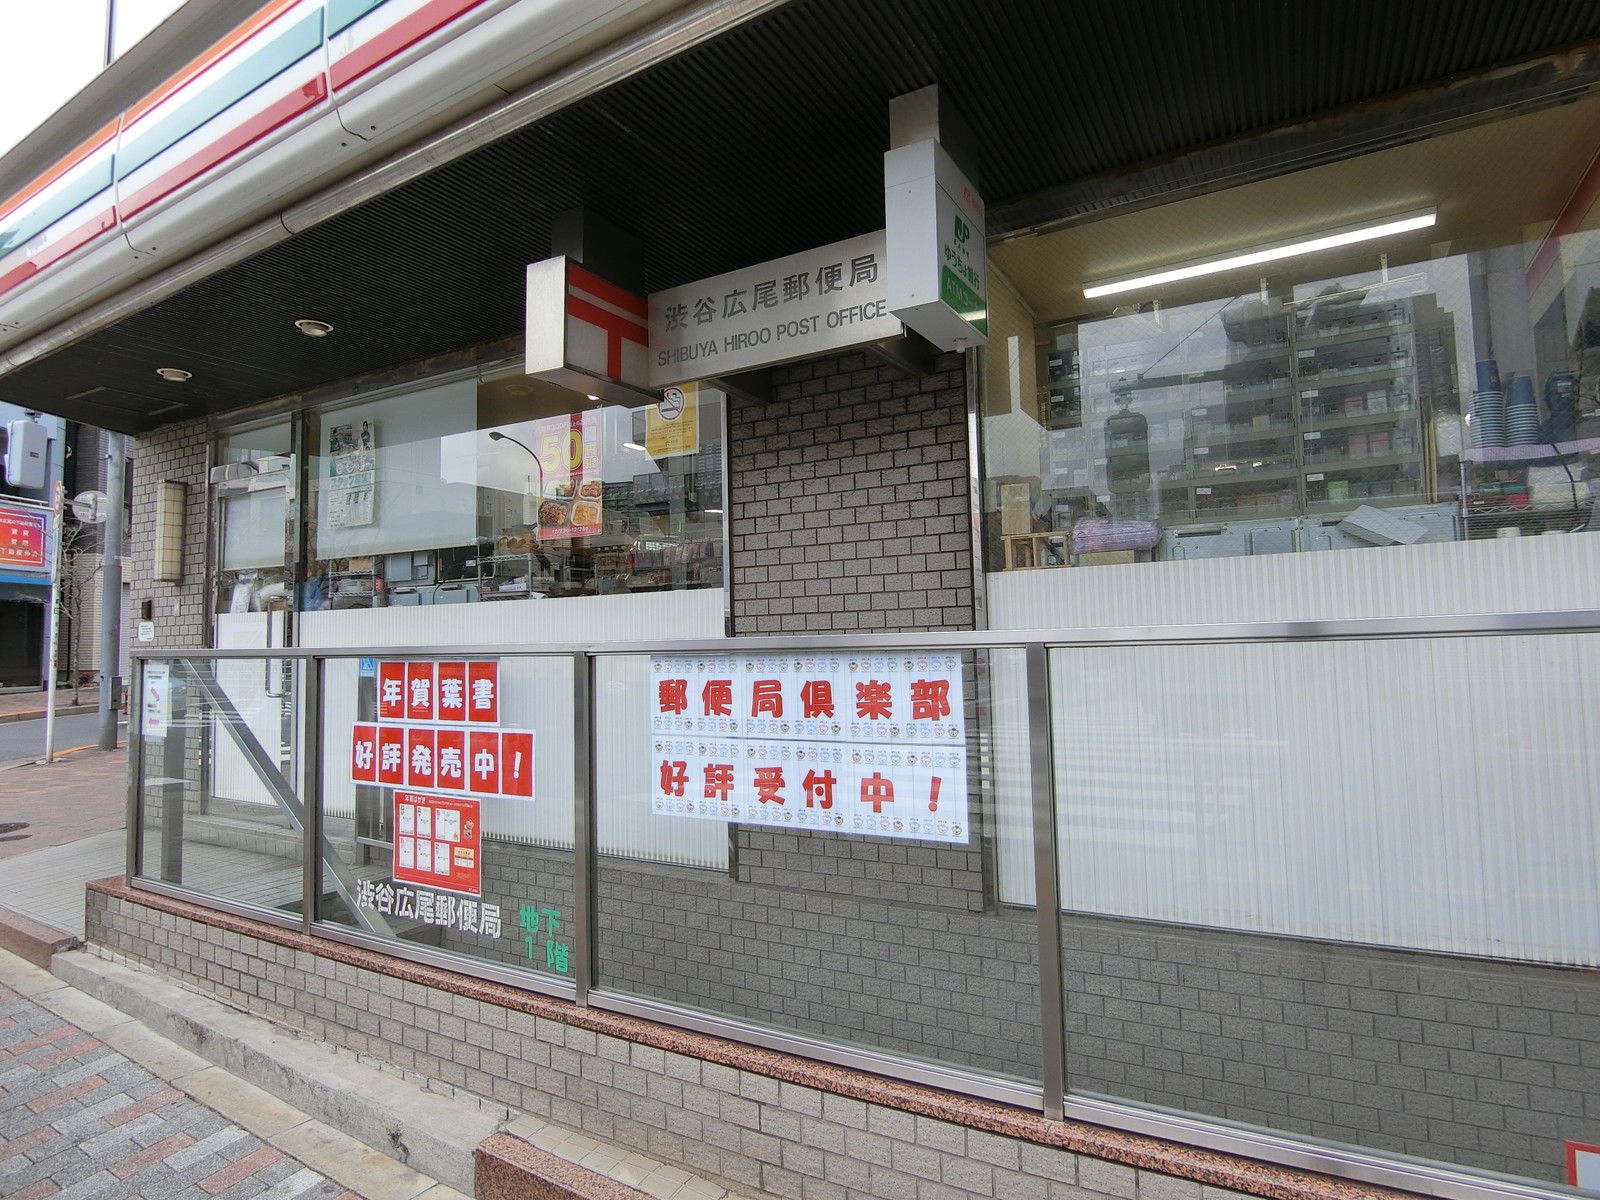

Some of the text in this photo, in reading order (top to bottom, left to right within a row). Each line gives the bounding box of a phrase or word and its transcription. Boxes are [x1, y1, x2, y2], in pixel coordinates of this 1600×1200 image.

[944, 244, 980, 290] ゆうちょ銀行
[664, 254, 879, 333] 渋谷広尾郵便局
[946, 277, 982, 313] ATMコーナ
[658, 299, 887, 367] SHIBUYA HIROO POST OFFICE
[382, 678, 494, 709] 年賀葉書
[658, 678, 951, 721] 郵便局倶楽部
[357, 878, 502, 939] 渋谷広尾郵便局
[519, 903, 563, 937] 地下
[524, 936, 570, 973] 1階
